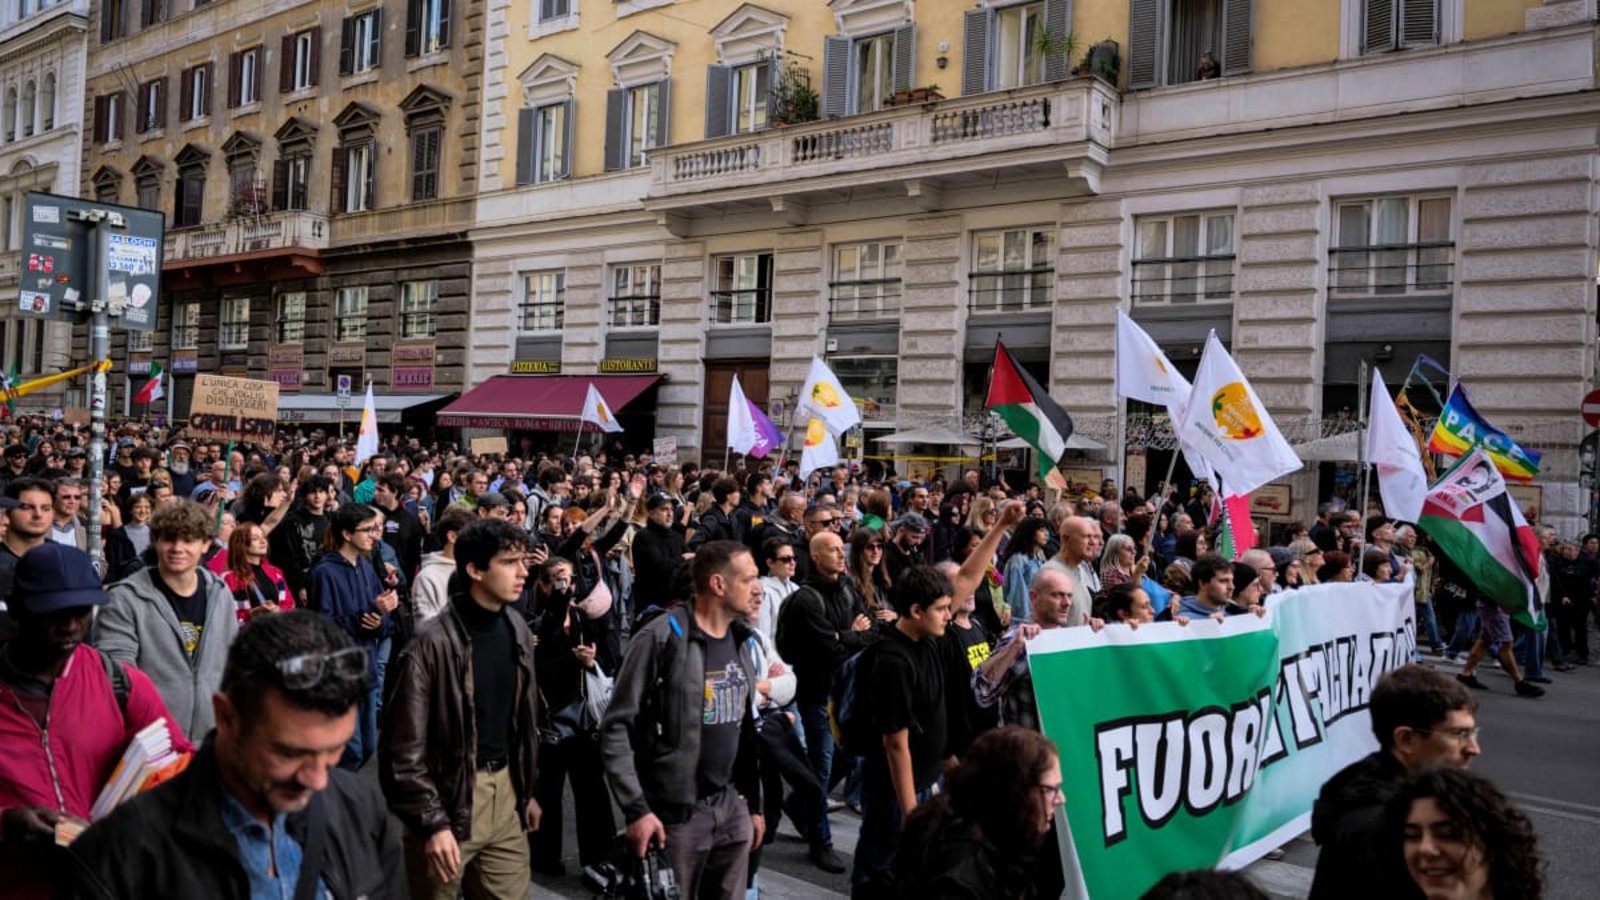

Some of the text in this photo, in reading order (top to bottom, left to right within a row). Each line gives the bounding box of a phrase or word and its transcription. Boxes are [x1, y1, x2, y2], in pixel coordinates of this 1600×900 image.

[602, 359, 653, 371] RISTORANTE
[514, 419, 542, 429] ROMA
[1445, 409, 1525, 463] PACE
[1093, 685, 1272, 849] FUORI
